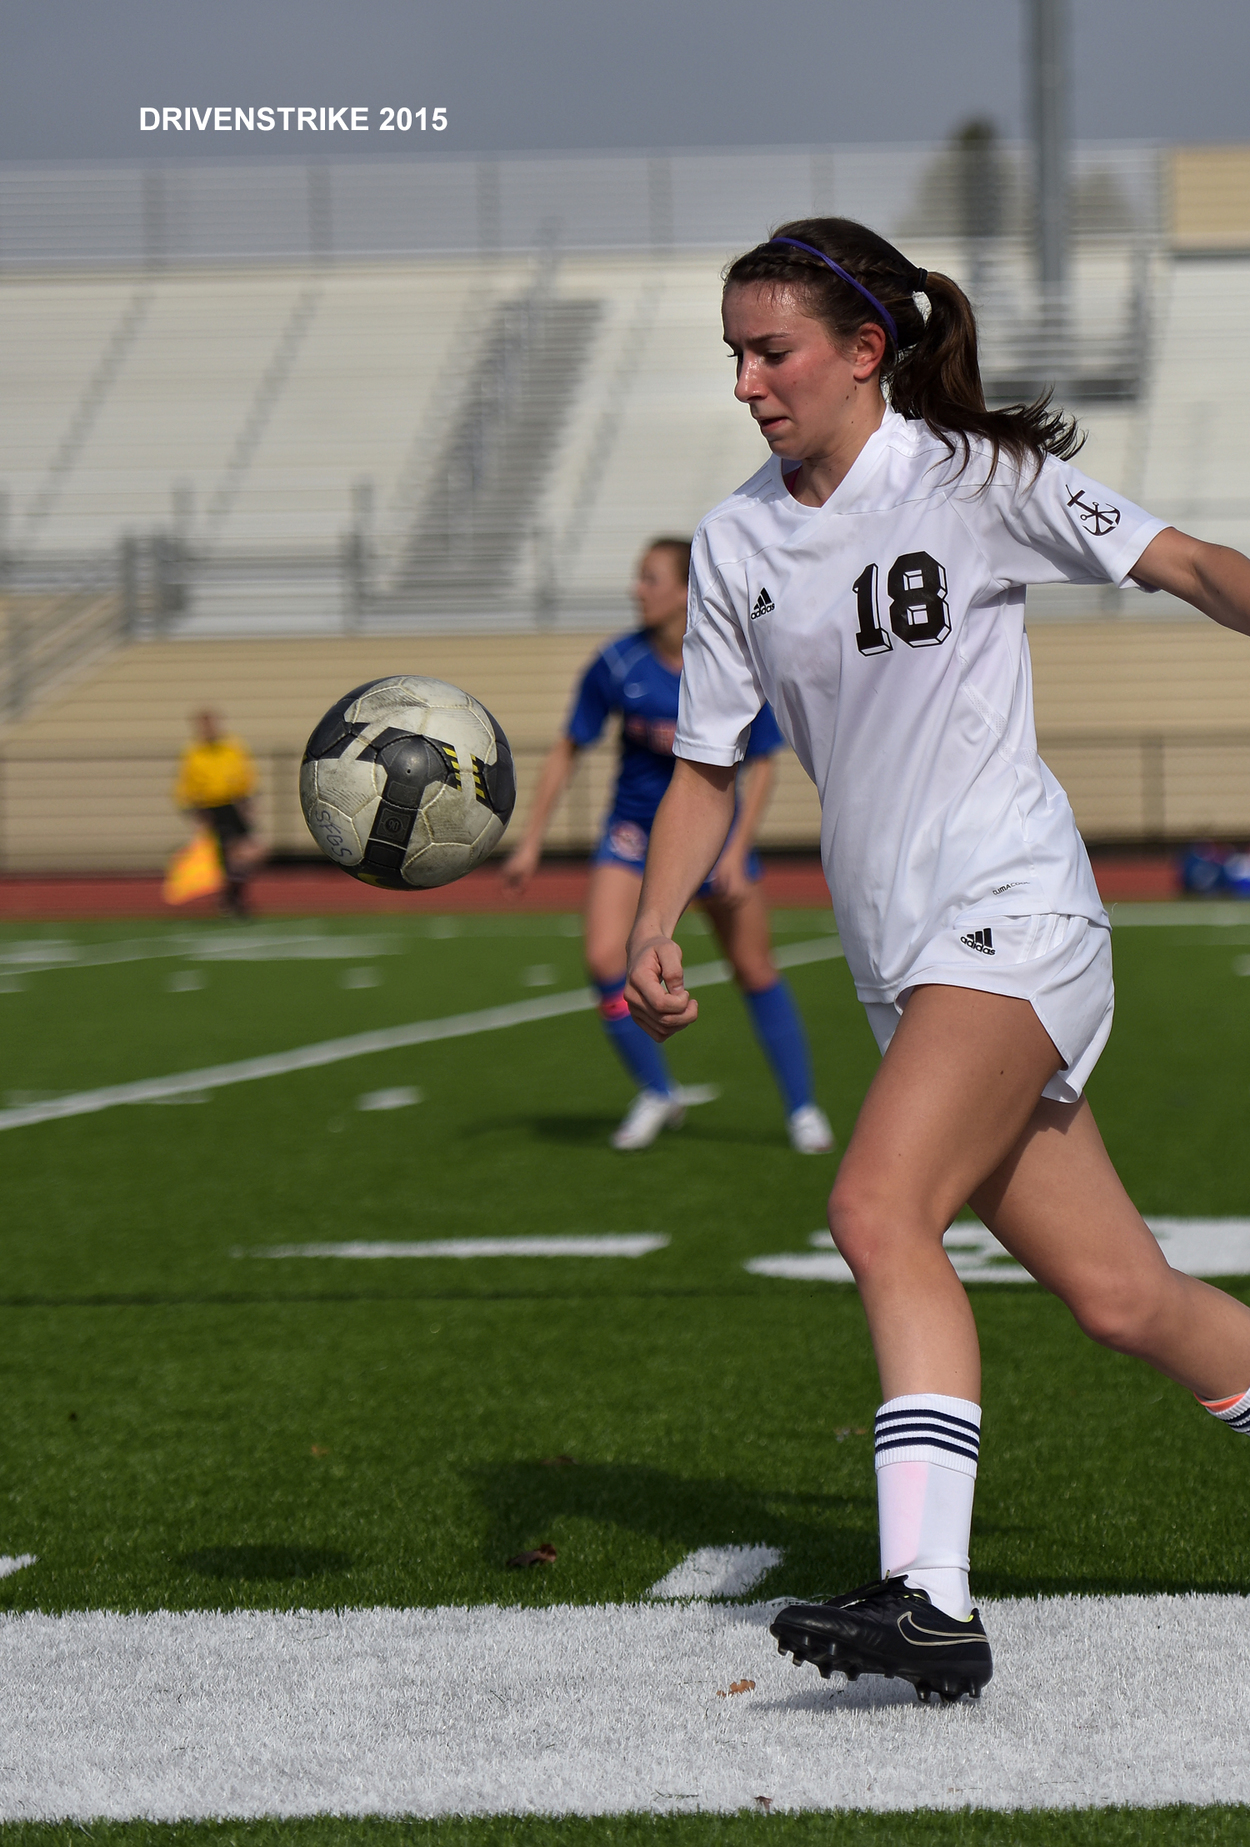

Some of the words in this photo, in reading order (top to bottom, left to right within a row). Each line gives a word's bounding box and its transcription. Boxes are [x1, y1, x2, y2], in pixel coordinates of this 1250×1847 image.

[750, 601, 776, 621] adidas
[852, 550, 952, 657] 18
[960, 936, 996, 956] adidas
